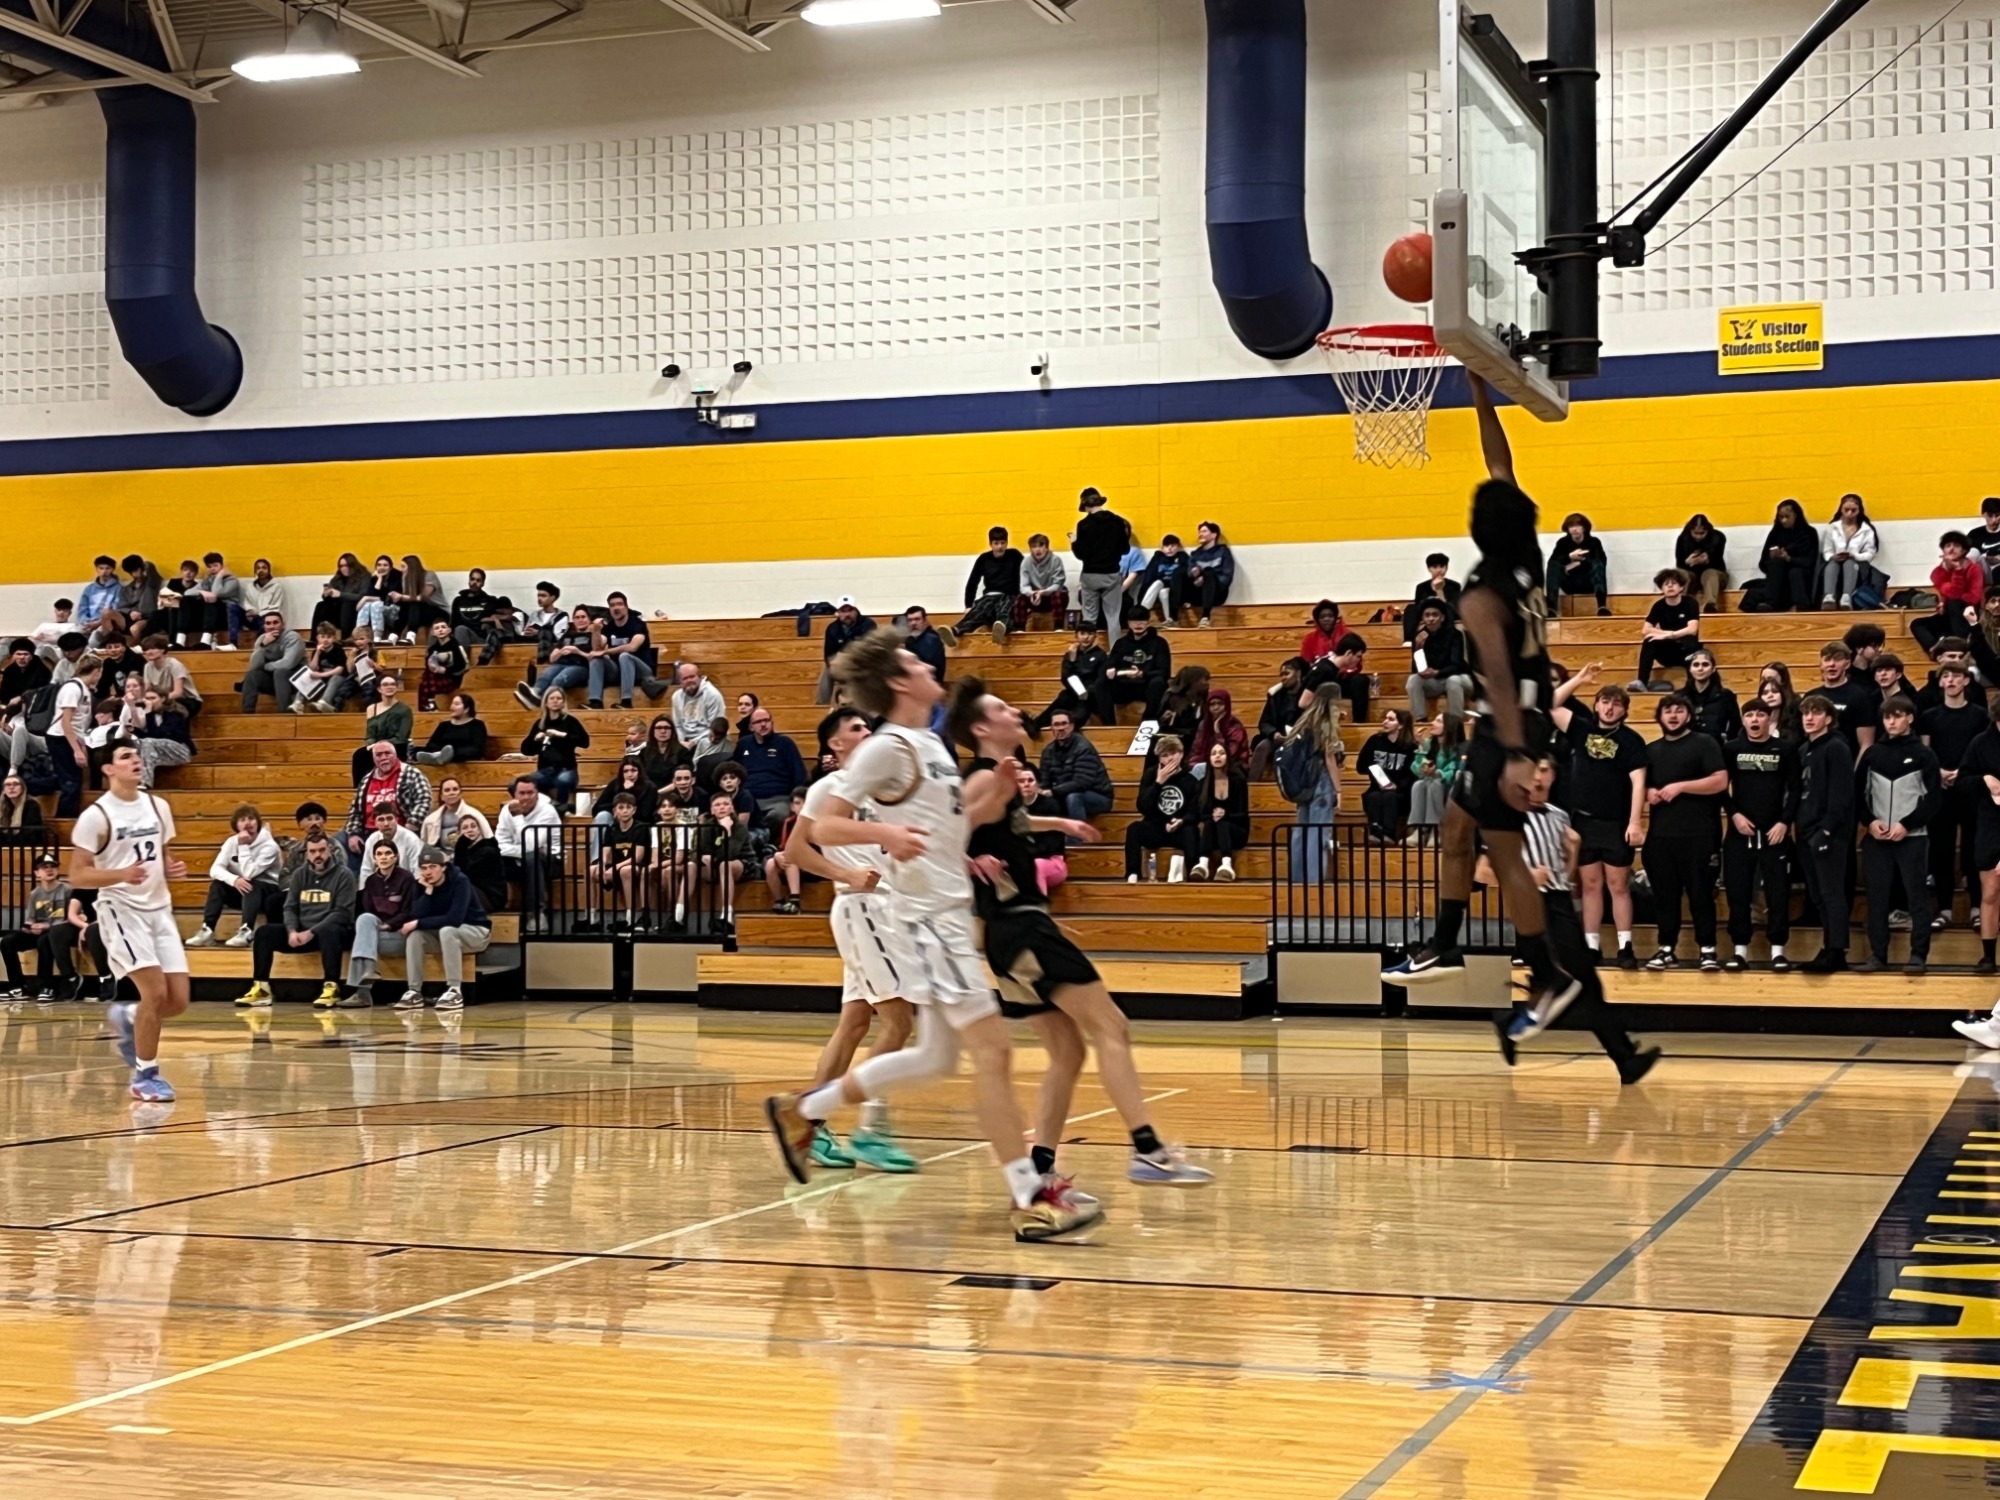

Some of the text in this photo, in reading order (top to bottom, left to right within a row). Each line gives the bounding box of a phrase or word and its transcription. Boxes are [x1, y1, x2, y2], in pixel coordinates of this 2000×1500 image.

[1762, 322, 1808, 336] Visitor
[1722, 339, 1820, 357] Students Section
[133, 840, 156, 862] 12
